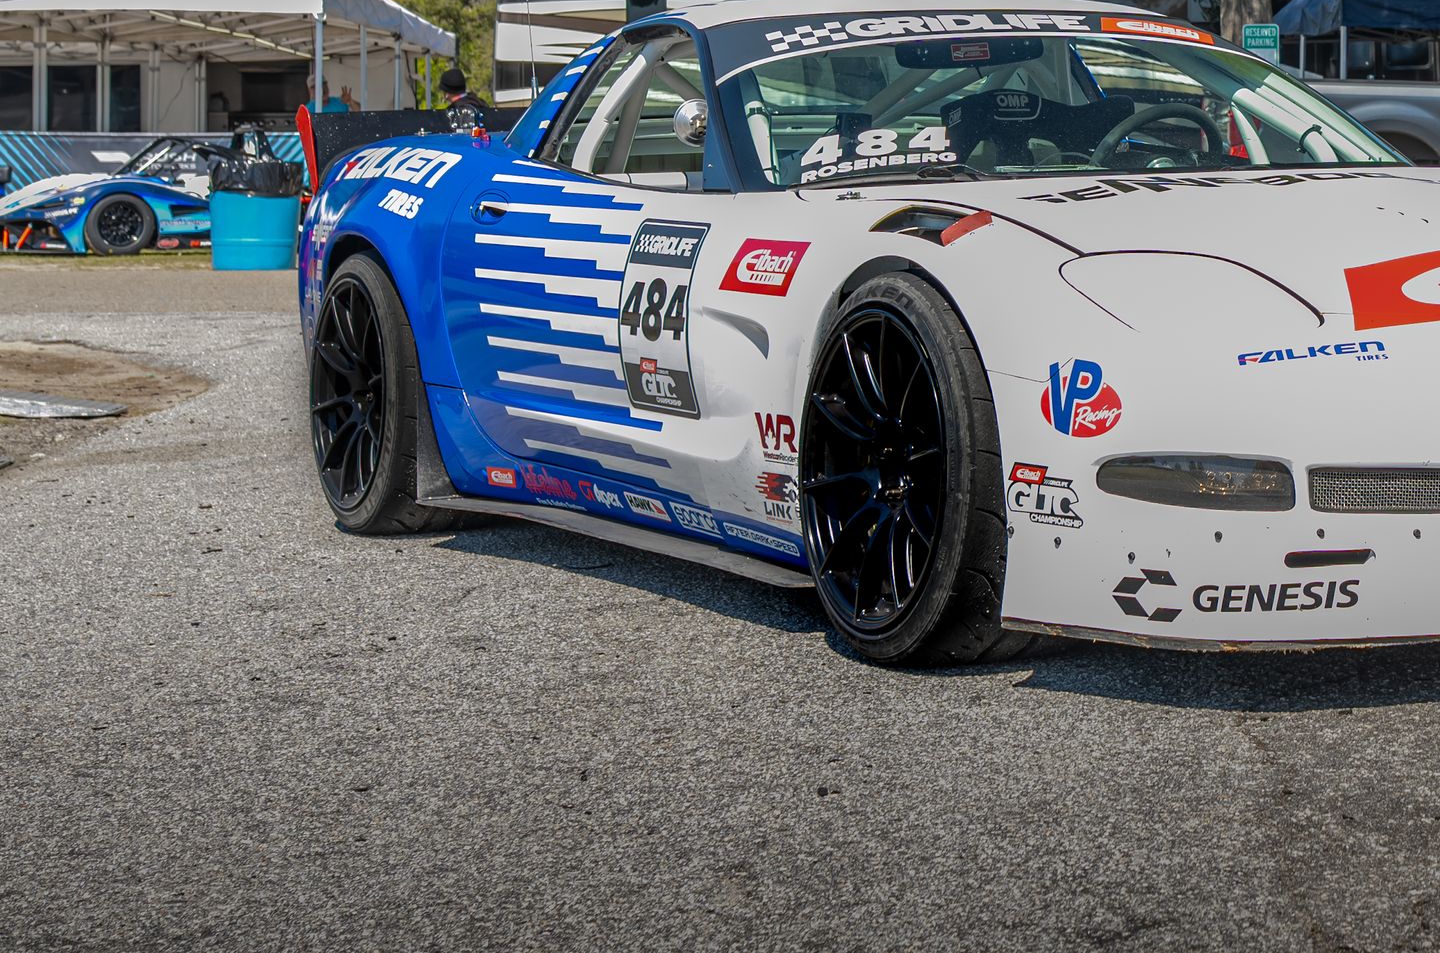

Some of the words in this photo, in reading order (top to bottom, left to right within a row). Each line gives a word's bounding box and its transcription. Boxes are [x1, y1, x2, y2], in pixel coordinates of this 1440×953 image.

[845, 13, 1091, 38] GRIDLIFE
[1115, 20, 1200, 40] Eibach
[1245, 27, 1277, 37] RESERVED
[1247, 38, 1275, 47] PARKING
[996, 95, 1029, 108] OMP
[335, 146, 463, 189] FALKEN
[801, 152, 957, 184] ROSENBERG
[377, 188, 425, 220] TIRES
[649, 236, 699, 257] GRIDLIFE
[736, 248, 797, 286] Eibach
[620, 277, 688, 342] 484
[1237, 340, 1386, 366] FALKEN
[1355, 353, 1389, 362] TIRES
[641, 372, 678, 398] GLTC
[1048, 358, 1103, 436] VP
[1074, 404, 1122, 430] Racing
[754, 412, 798, 453] WR
[490, 470, 514, 484] Eibach
[1015, 468, 1041, 481] Eibach
[626, 495, 655, 512] HAWK
[764, 501, 792, 520] LINK
[1007, 480, 1079, 516] GLTC
[1030, 513, 1082, 528] CHAMPIONSHIP
[1192, 579, 1360, 613] GENESIS
